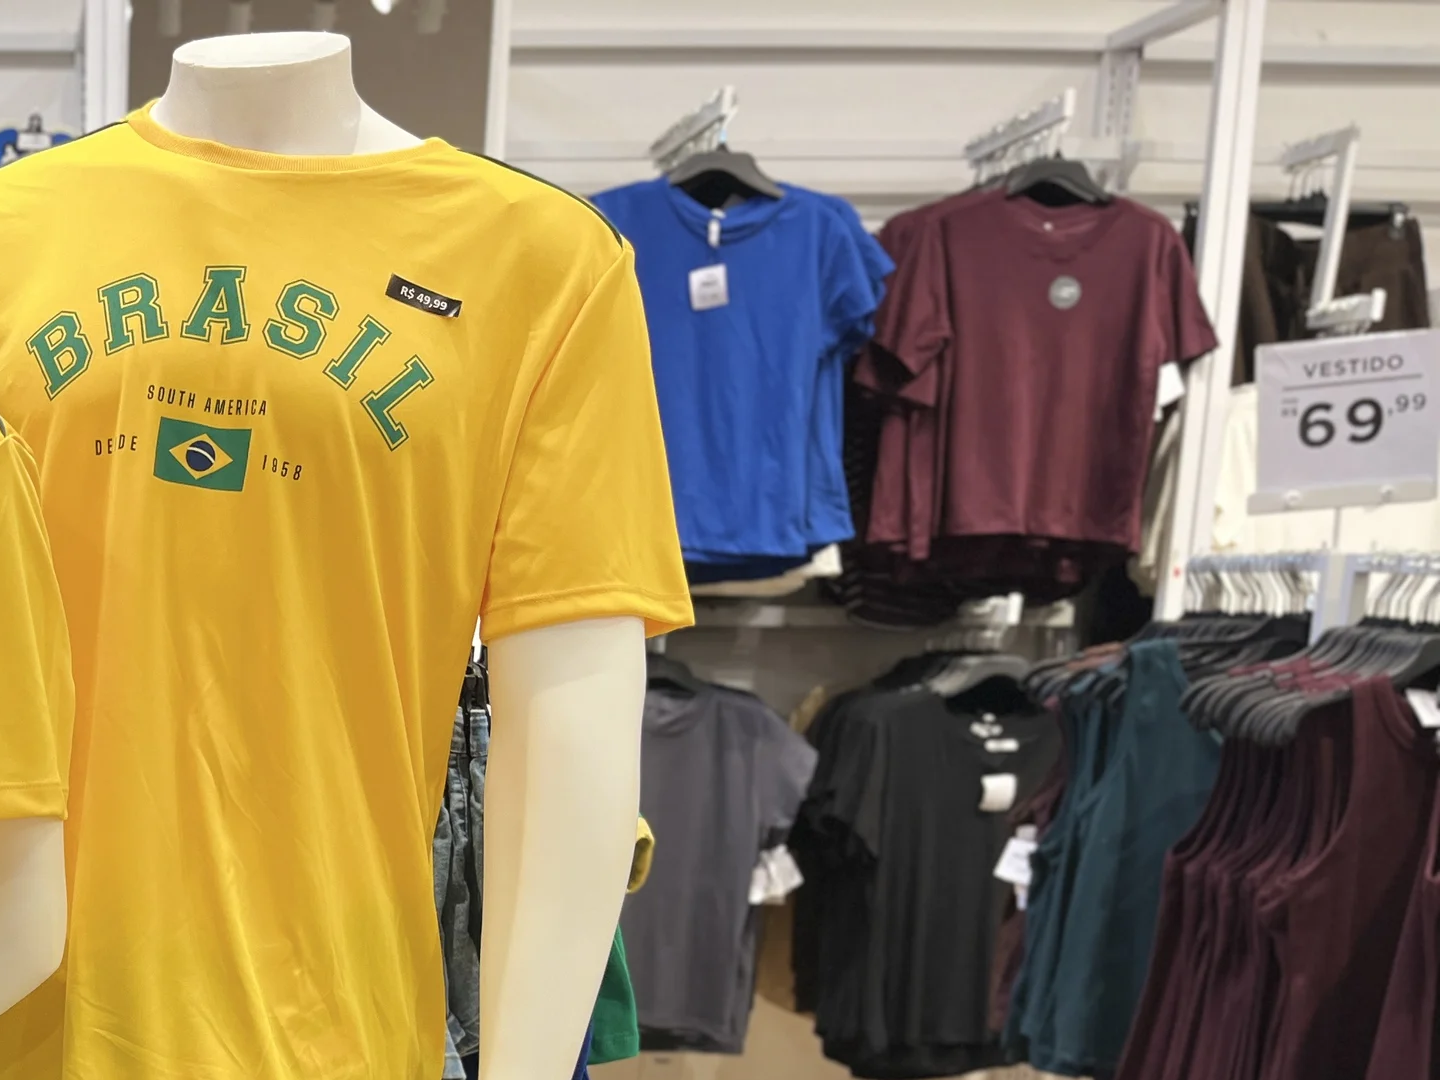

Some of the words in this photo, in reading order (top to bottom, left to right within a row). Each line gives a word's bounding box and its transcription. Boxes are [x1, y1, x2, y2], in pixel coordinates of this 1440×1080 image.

[400, 285, 415, 299] R$
[417, 293, 448, 311] 49,99
[26, 265, 435, 451] BRASIL
[1303, 354, 1404, 378] VESTIDO
[147, 384, 196, 408] SOUTH
[204, 397, 267, 415] AMERICA
[95, 434, 138, 456] DEDE
